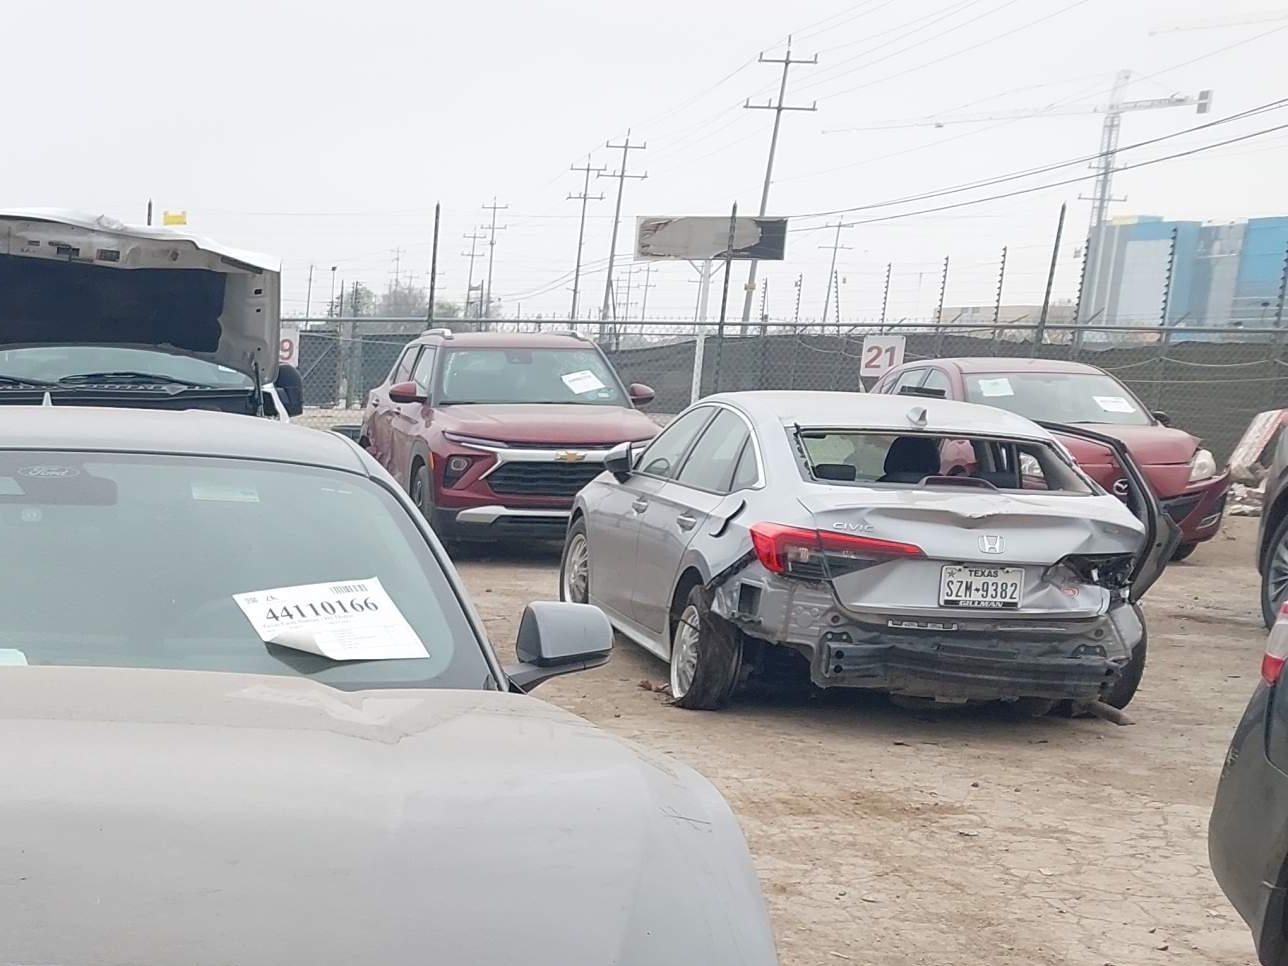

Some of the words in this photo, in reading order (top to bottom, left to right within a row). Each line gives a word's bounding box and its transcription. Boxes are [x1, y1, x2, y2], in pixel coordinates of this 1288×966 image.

[279, 338, 294, 361] 9
[864, 345, 897, 368] 21
[832, 521, 875, 534] CIVIC
[968, 569, 1000, 579] TEXAS
[265, 596, 380, 622] 44110166
[958, 600, 1004, 609] GILLMAN
